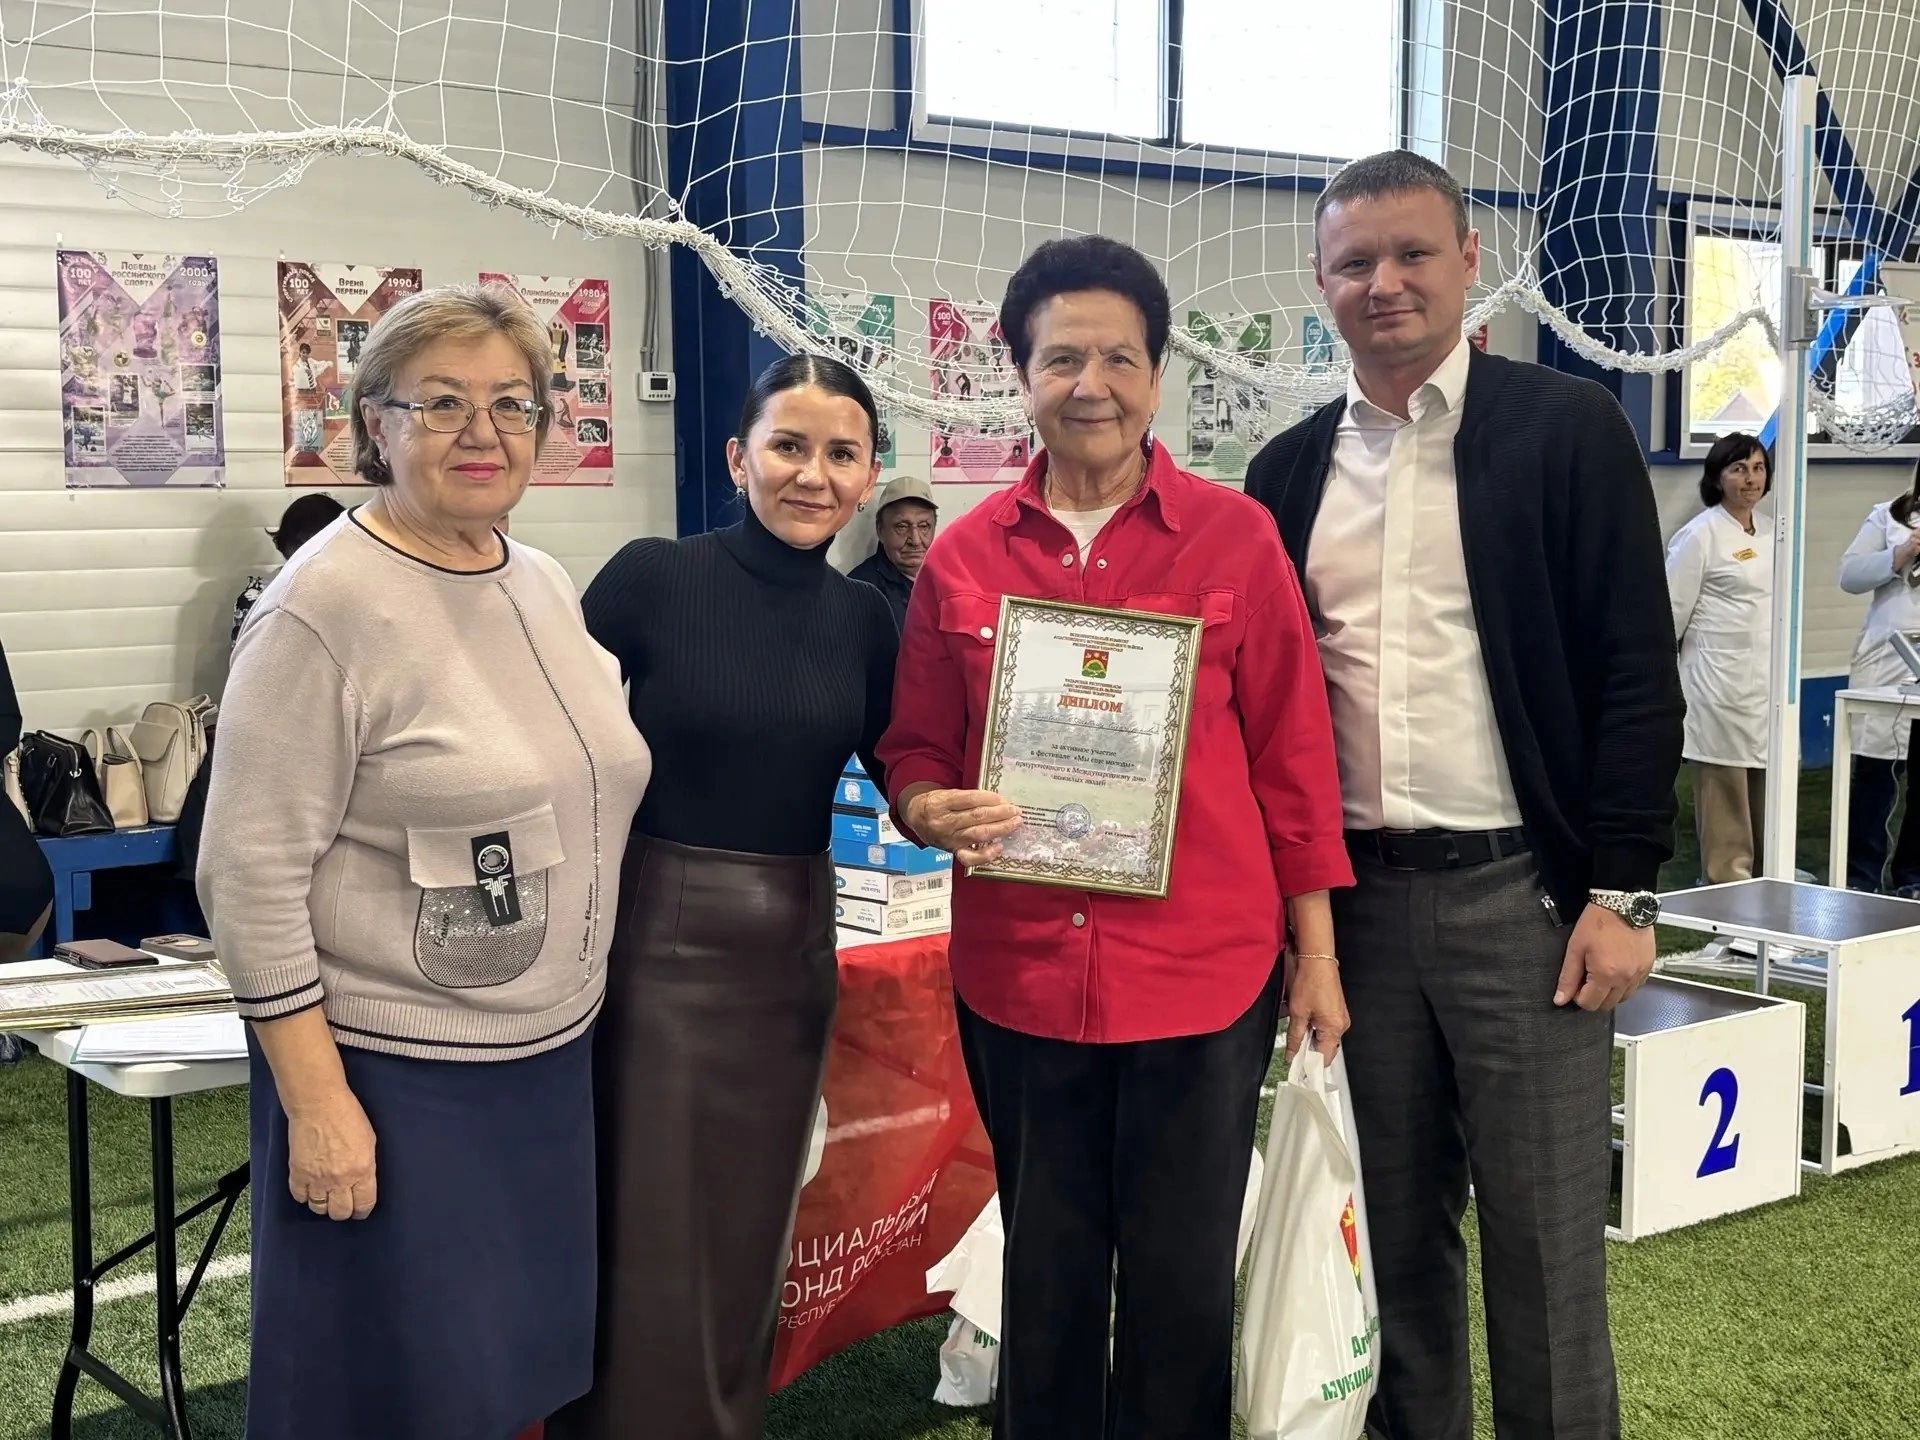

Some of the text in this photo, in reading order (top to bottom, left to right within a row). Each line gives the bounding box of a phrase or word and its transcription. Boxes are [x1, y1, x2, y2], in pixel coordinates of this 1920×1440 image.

[70, 267, 92, 279] 100
[289, 278, 309, 289] 100
[937, 312, 952, 321] 100
[1057, 694, 1124, 713] ДИПЛОМ
[1091, 748, 1117, 757] участие
[1696, 1067, 1740, 1178] 2
[787, 1168, 939, 1268] ЦИАЛЬНЫЙ
[781, 1265, 844, 1308] ОНД
